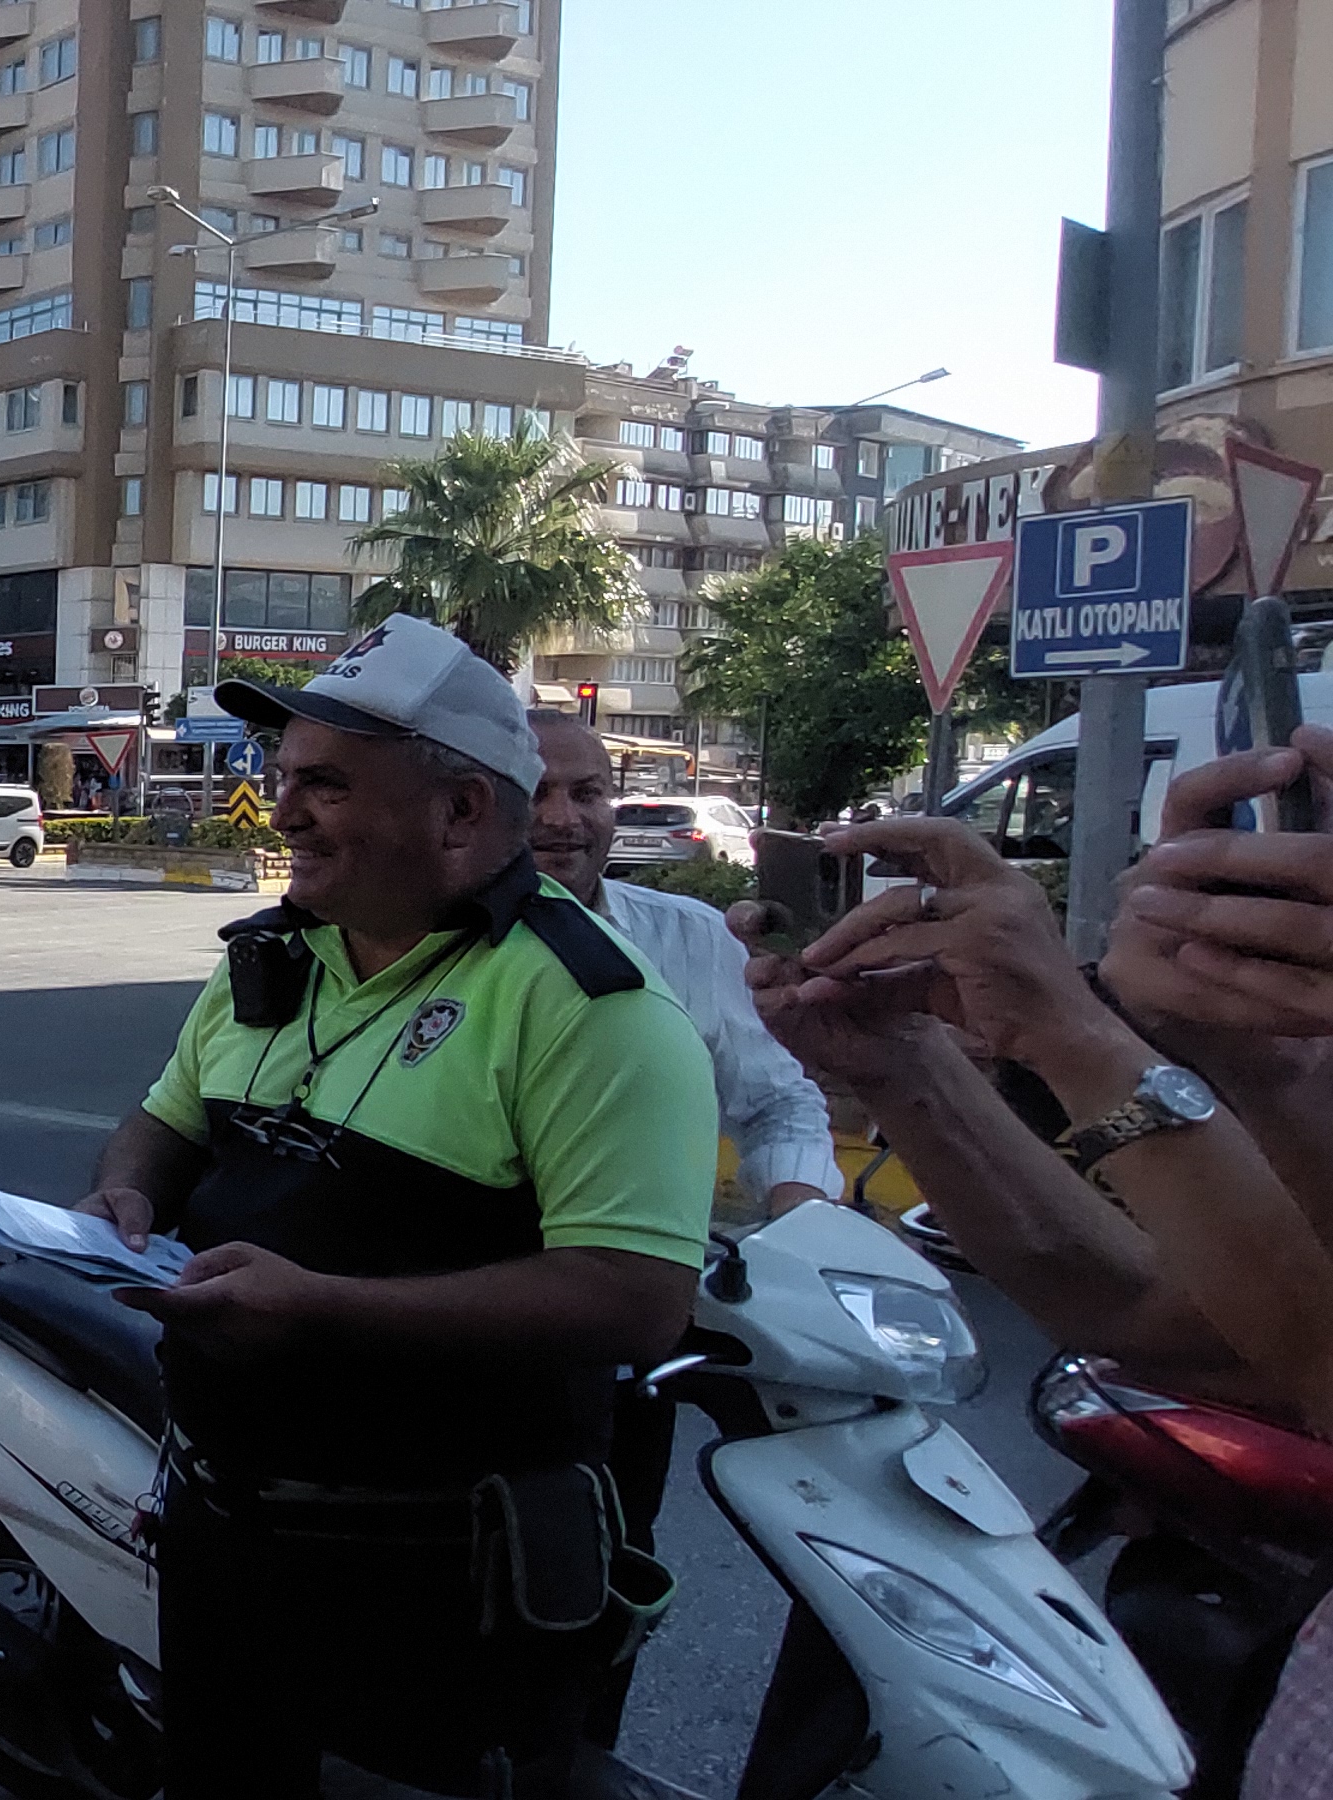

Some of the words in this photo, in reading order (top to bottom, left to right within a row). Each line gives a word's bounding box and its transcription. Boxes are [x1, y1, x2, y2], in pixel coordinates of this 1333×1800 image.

[1073, 525, 1127, 587] P
[1017, 606, 1074, 642] KATLI
[1079, 598, 1182, 638] OTOPARK
[234, 634, 289, 651] BURGER
[293, 636, 328, 653] KING
